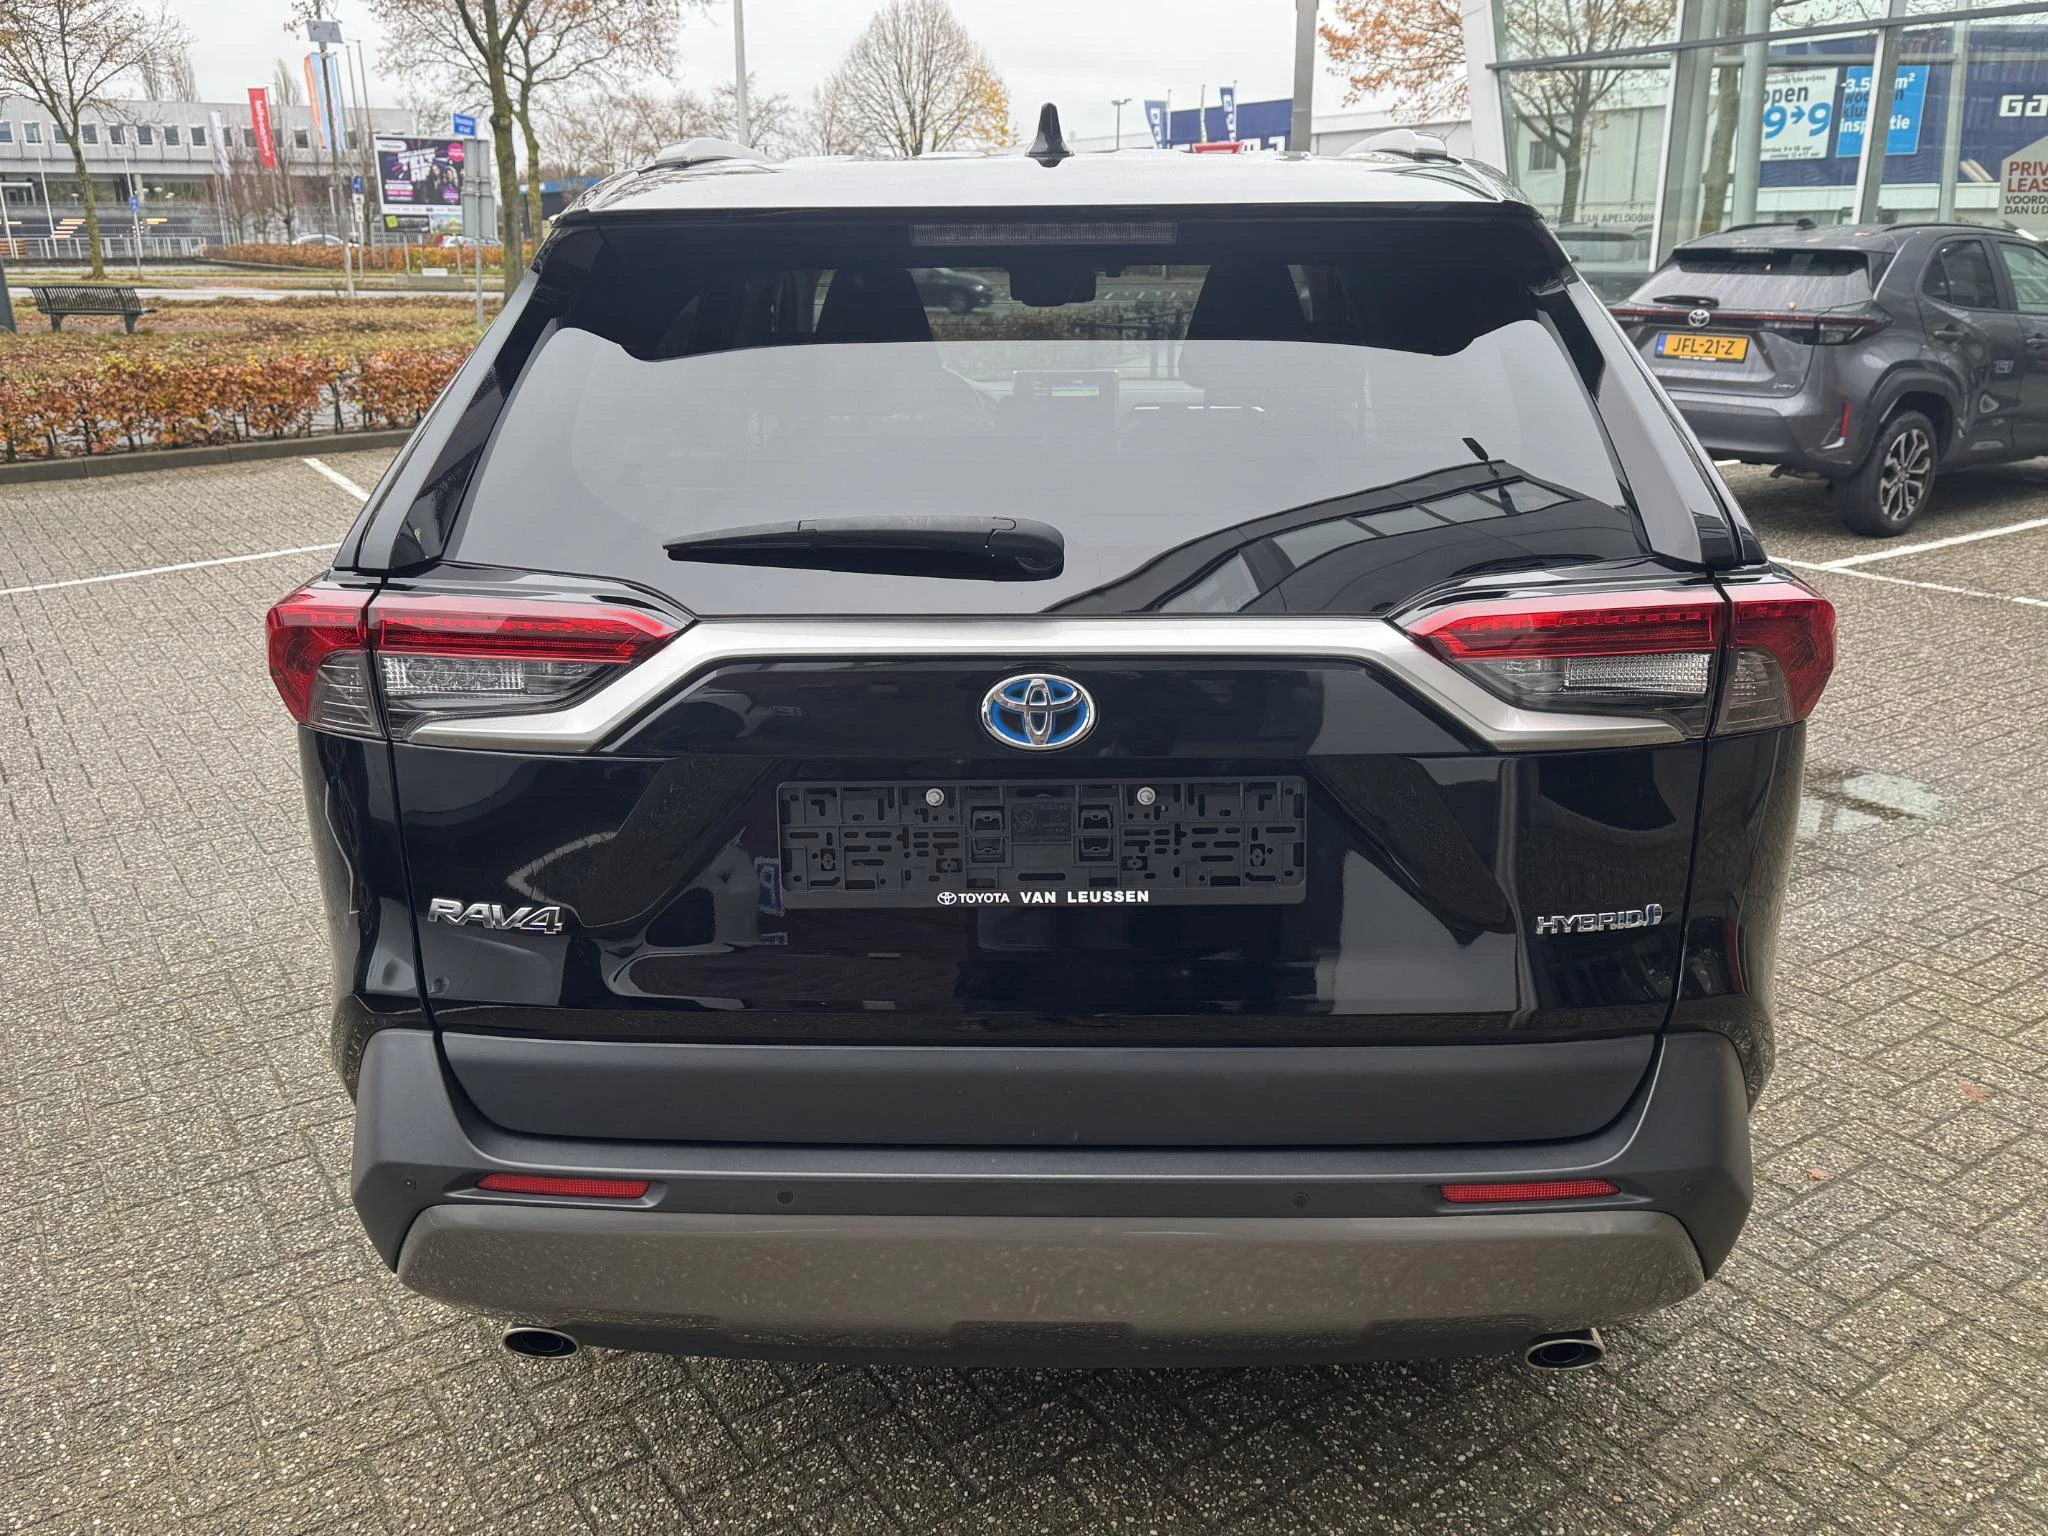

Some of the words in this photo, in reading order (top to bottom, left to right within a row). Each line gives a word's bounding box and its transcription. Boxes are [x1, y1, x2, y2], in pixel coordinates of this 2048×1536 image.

[2005, 195, 2048, 205] VOORD
[2004, 205, 2029, 215] DAN
[2031, 205, 2039, 215] U
[1673, 337, 1736, 356] JFL-21-Z
[957, 893, 1010, 905] TOYOTA
[1020, 891, 1056, 904] VAN
[1067, 889, 1149, 904] LEUSSEN
[427, 897, 563, 935] RAV4
[1536, 909, 1643, 935] HYBRID
